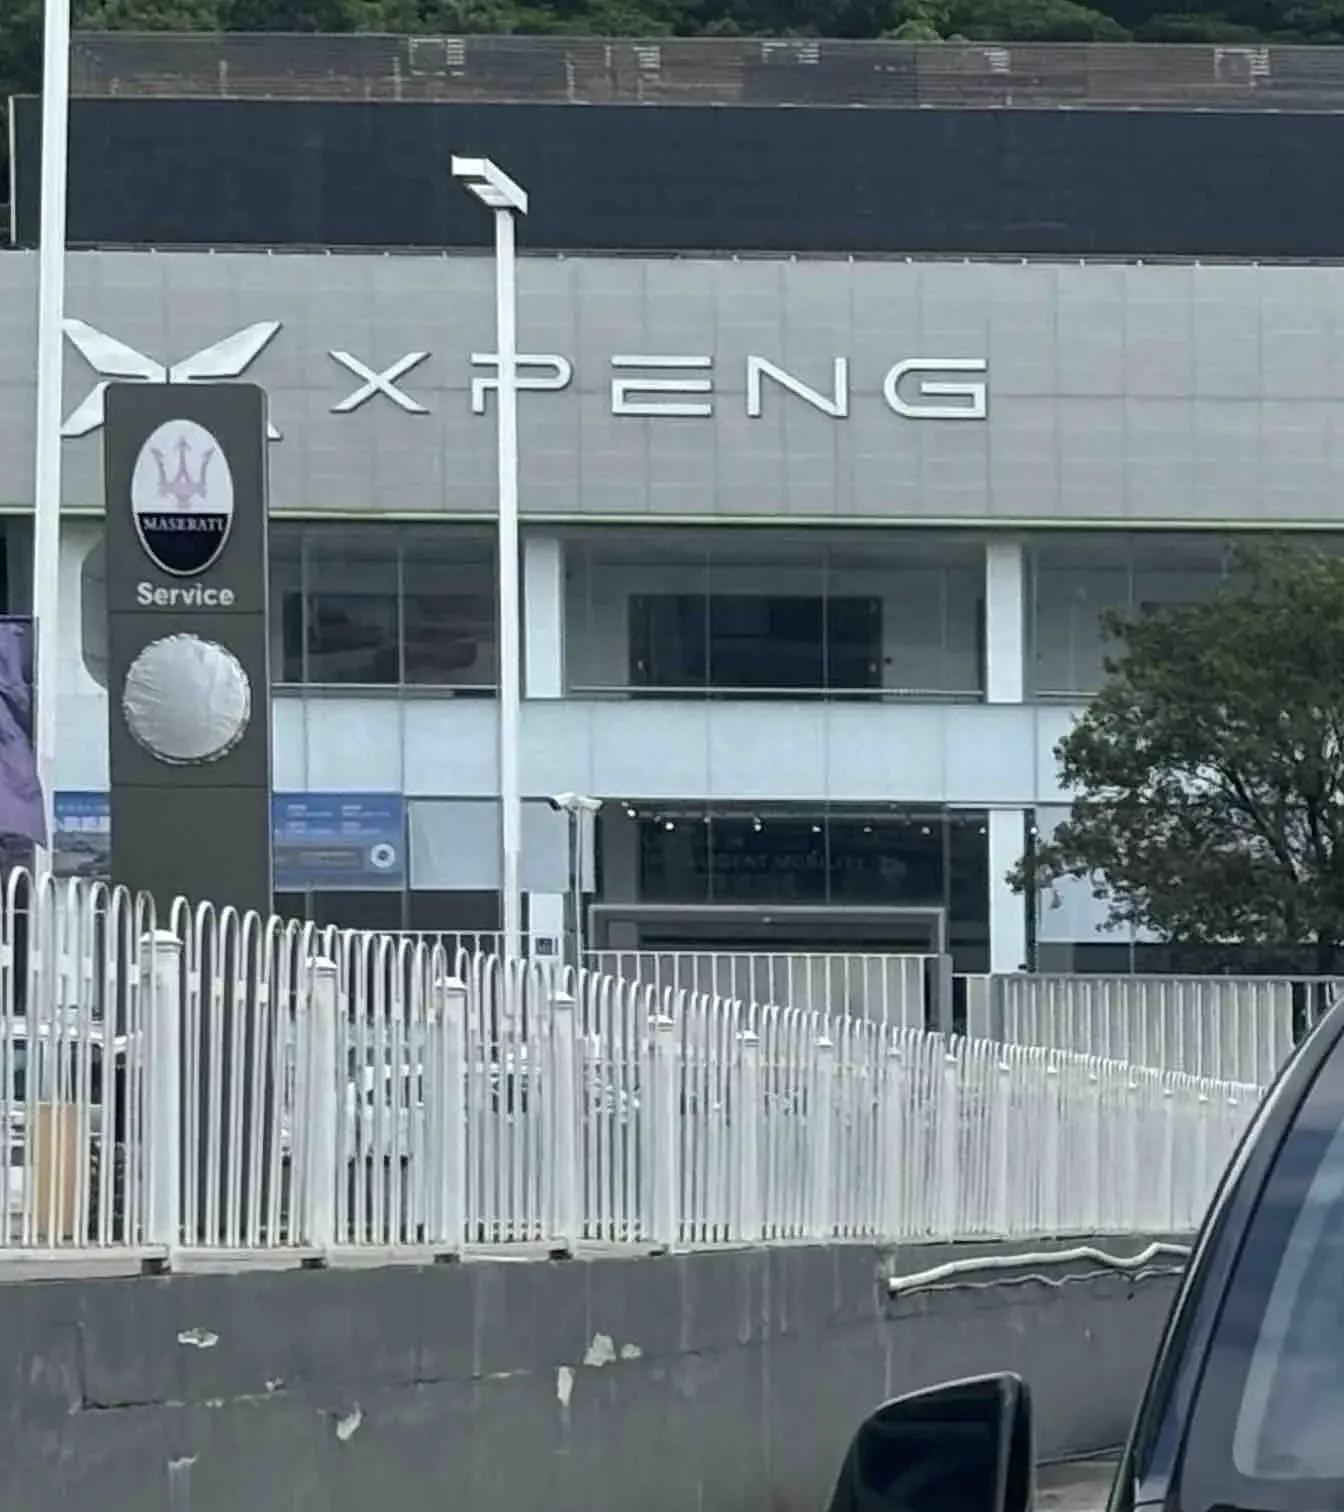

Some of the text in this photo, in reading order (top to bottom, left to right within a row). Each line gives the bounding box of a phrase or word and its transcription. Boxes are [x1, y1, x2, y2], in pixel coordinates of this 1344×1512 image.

[328, 351, 988, 418] XPENG
[142, 517, 225, 532] MASERATI
[135, 581, 235, 606] Service
